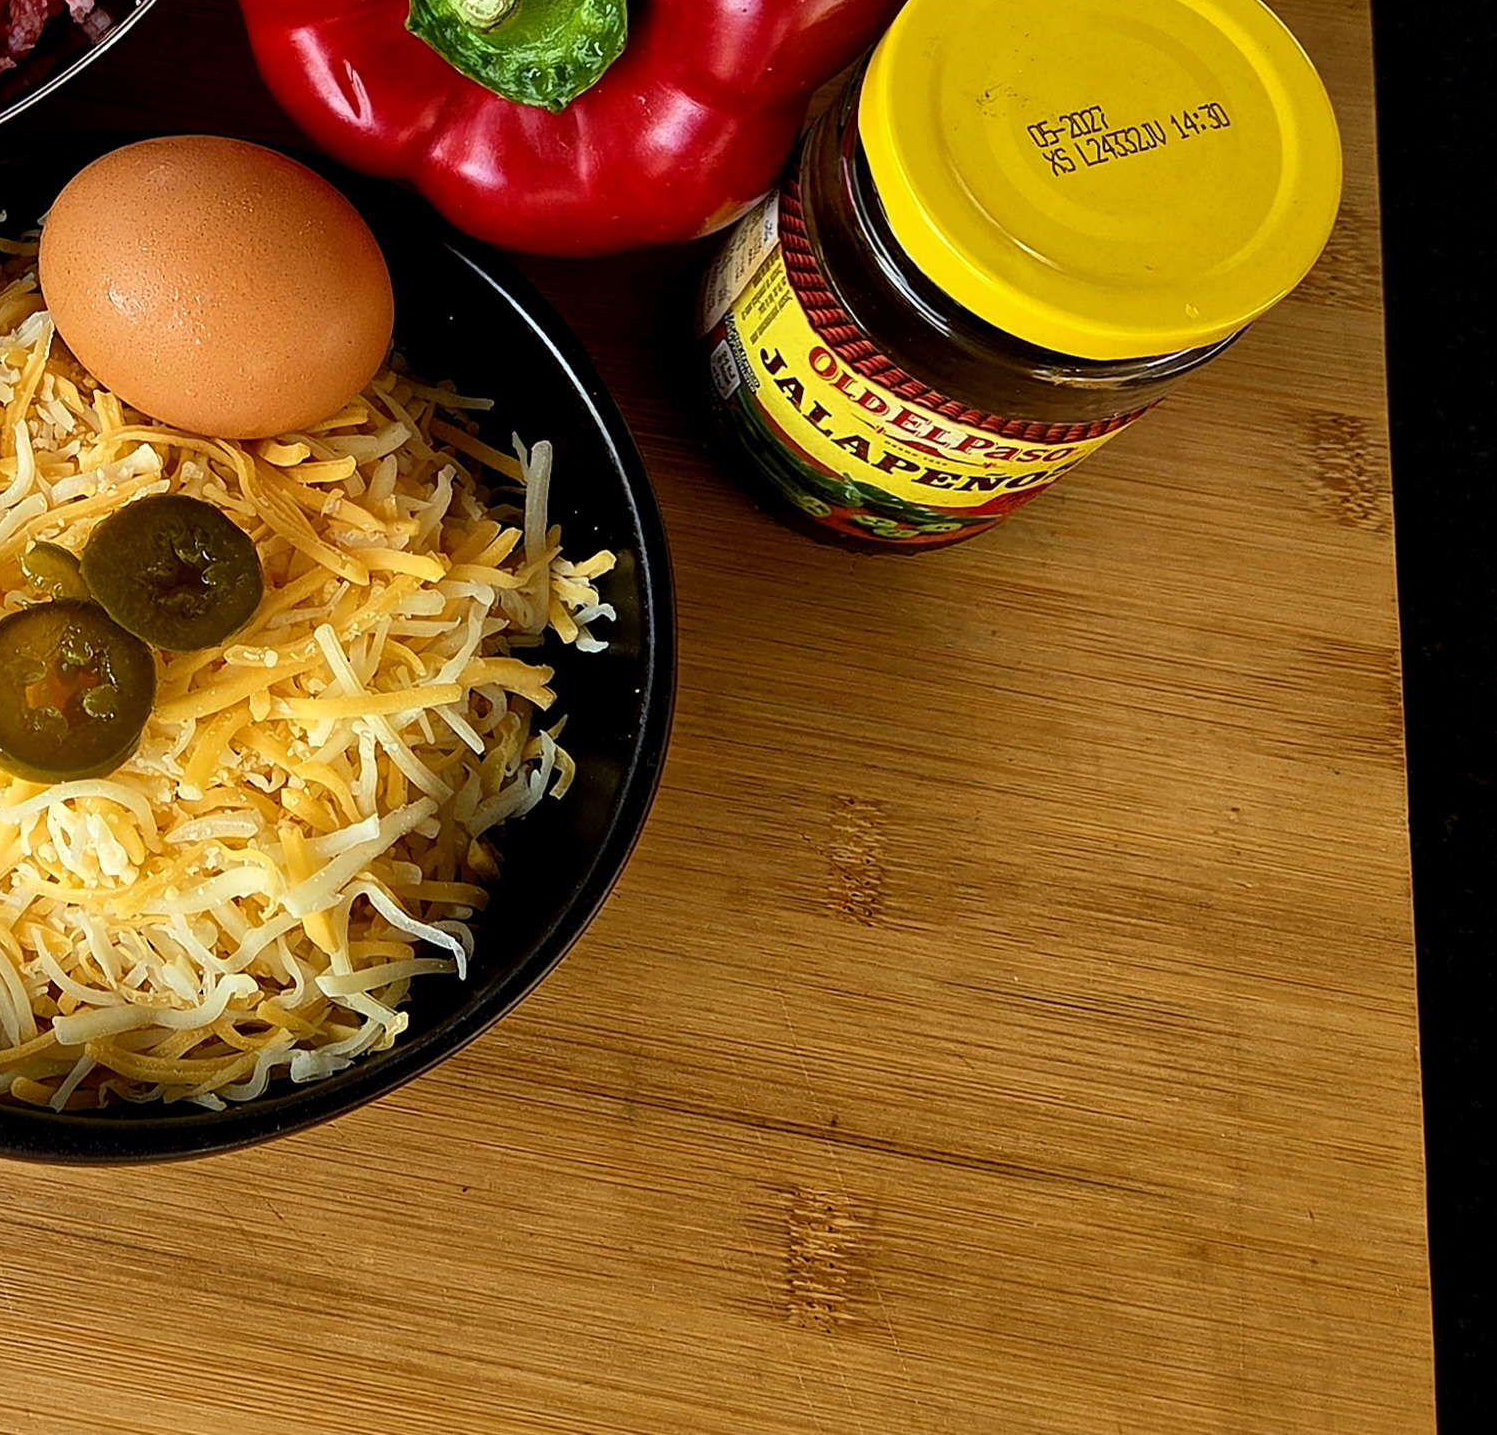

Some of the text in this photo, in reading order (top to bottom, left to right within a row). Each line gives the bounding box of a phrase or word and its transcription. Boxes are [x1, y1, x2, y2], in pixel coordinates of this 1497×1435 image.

[1027, 105, 1110, 148] 05-2027
[1042, 147, 1076, 177] XS
[1170, 102, 1231, 140] 14:30
